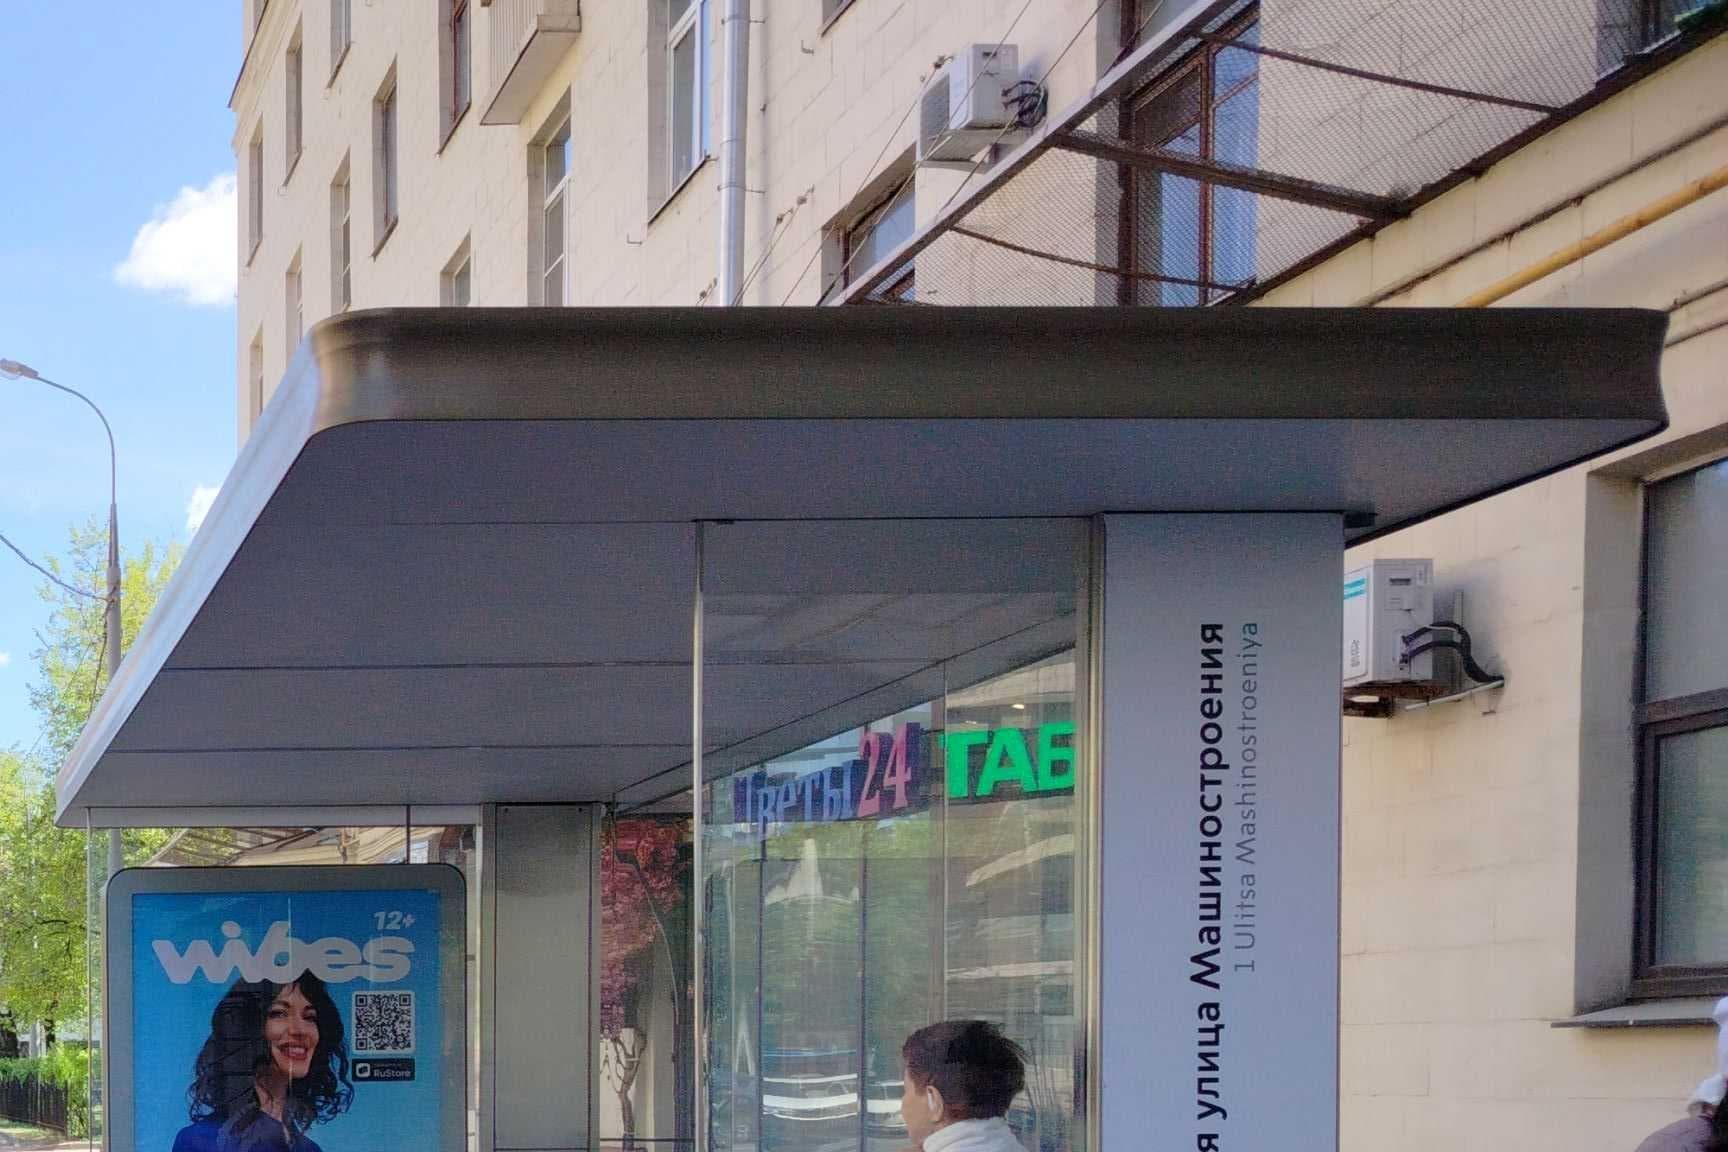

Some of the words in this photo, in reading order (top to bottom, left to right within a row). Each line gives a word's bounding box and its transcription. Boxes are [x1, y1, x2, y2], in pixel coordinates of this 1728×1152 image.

[856, 722, 912, 817] 24
[938, 720, 1074, 800] ТАБ
[1235, 622, 1263, 865] Mashinostroeniya
[1190, 623, 1230, 990] Машиностроения
[373, 910, 415, 930] 12+
[1234, 873, 1256, 949] Ulitsa
[1234, 960, 1255, 972] 1
[373, 1068, 411, 1078] RuStore
[1197, 1001, 1227, 1120] улица
